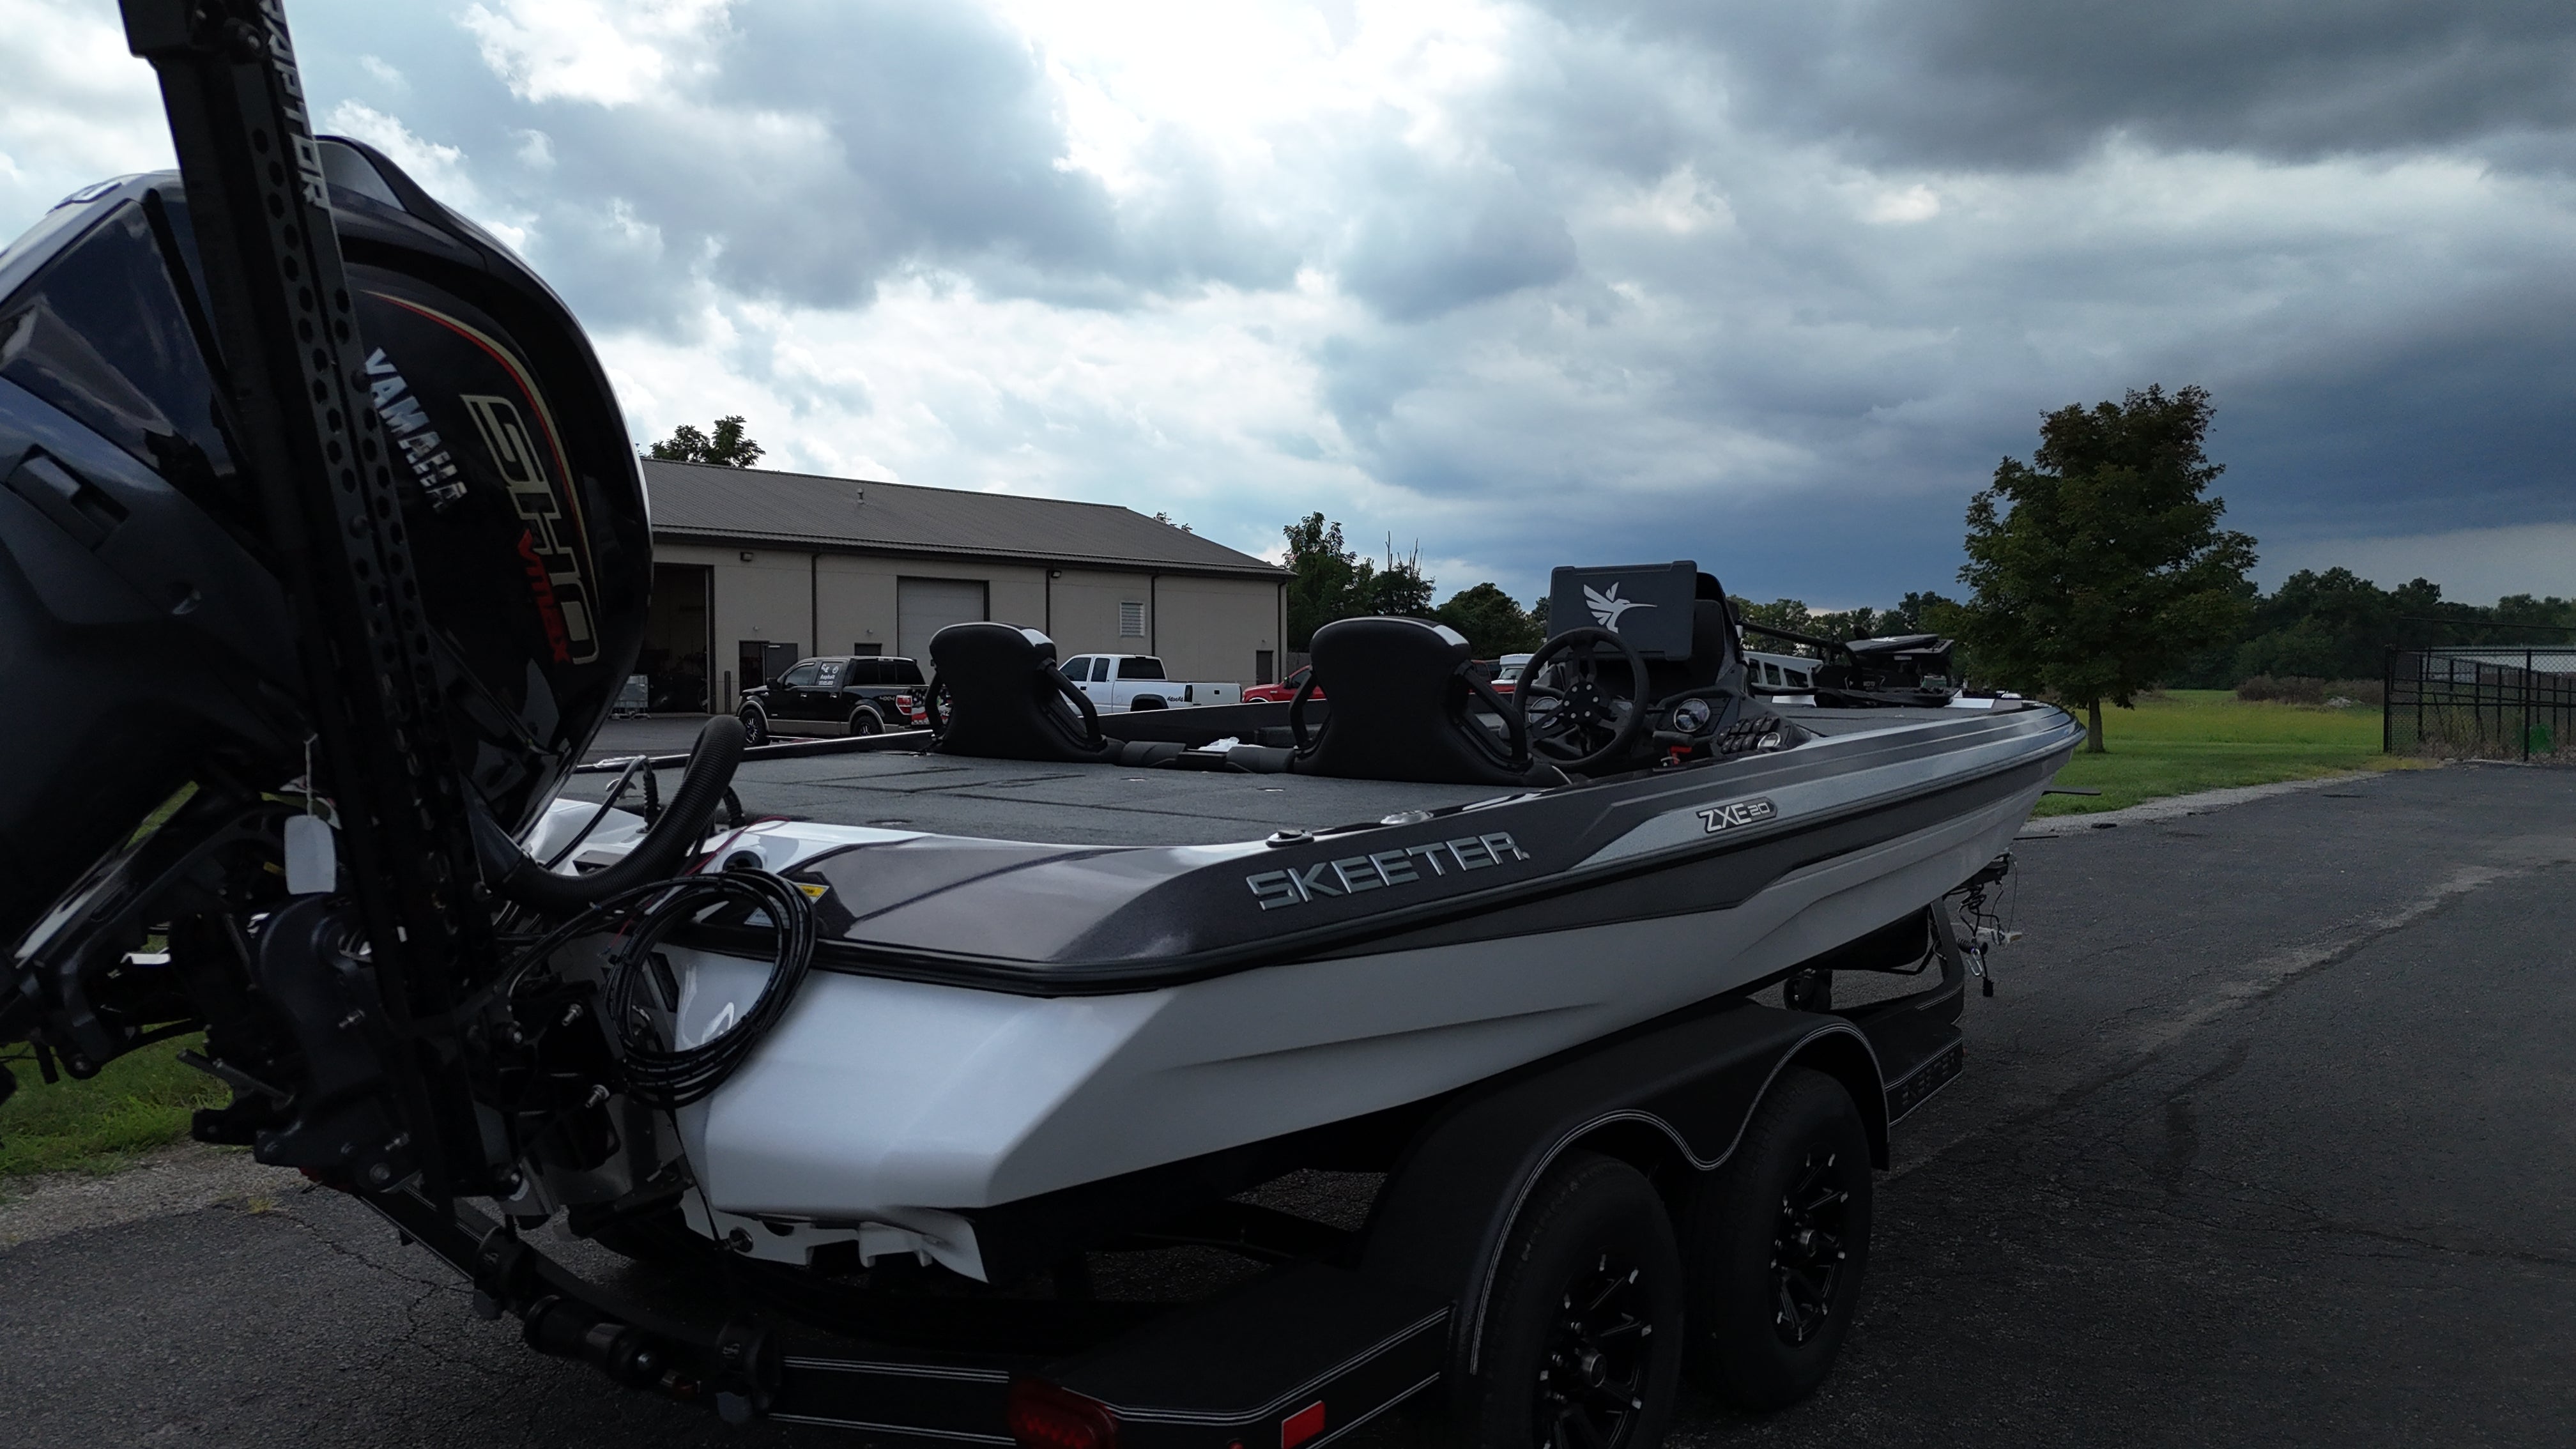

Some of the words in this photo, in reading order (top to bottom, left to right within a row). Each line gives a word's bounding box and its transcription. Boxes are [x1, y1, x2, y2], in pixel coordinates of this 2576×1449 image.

[365, 347, 468, 510] YAMAHA
[459, 394, 599, 664] SHO
[1246, 831, 1525, 911] SKEETER
